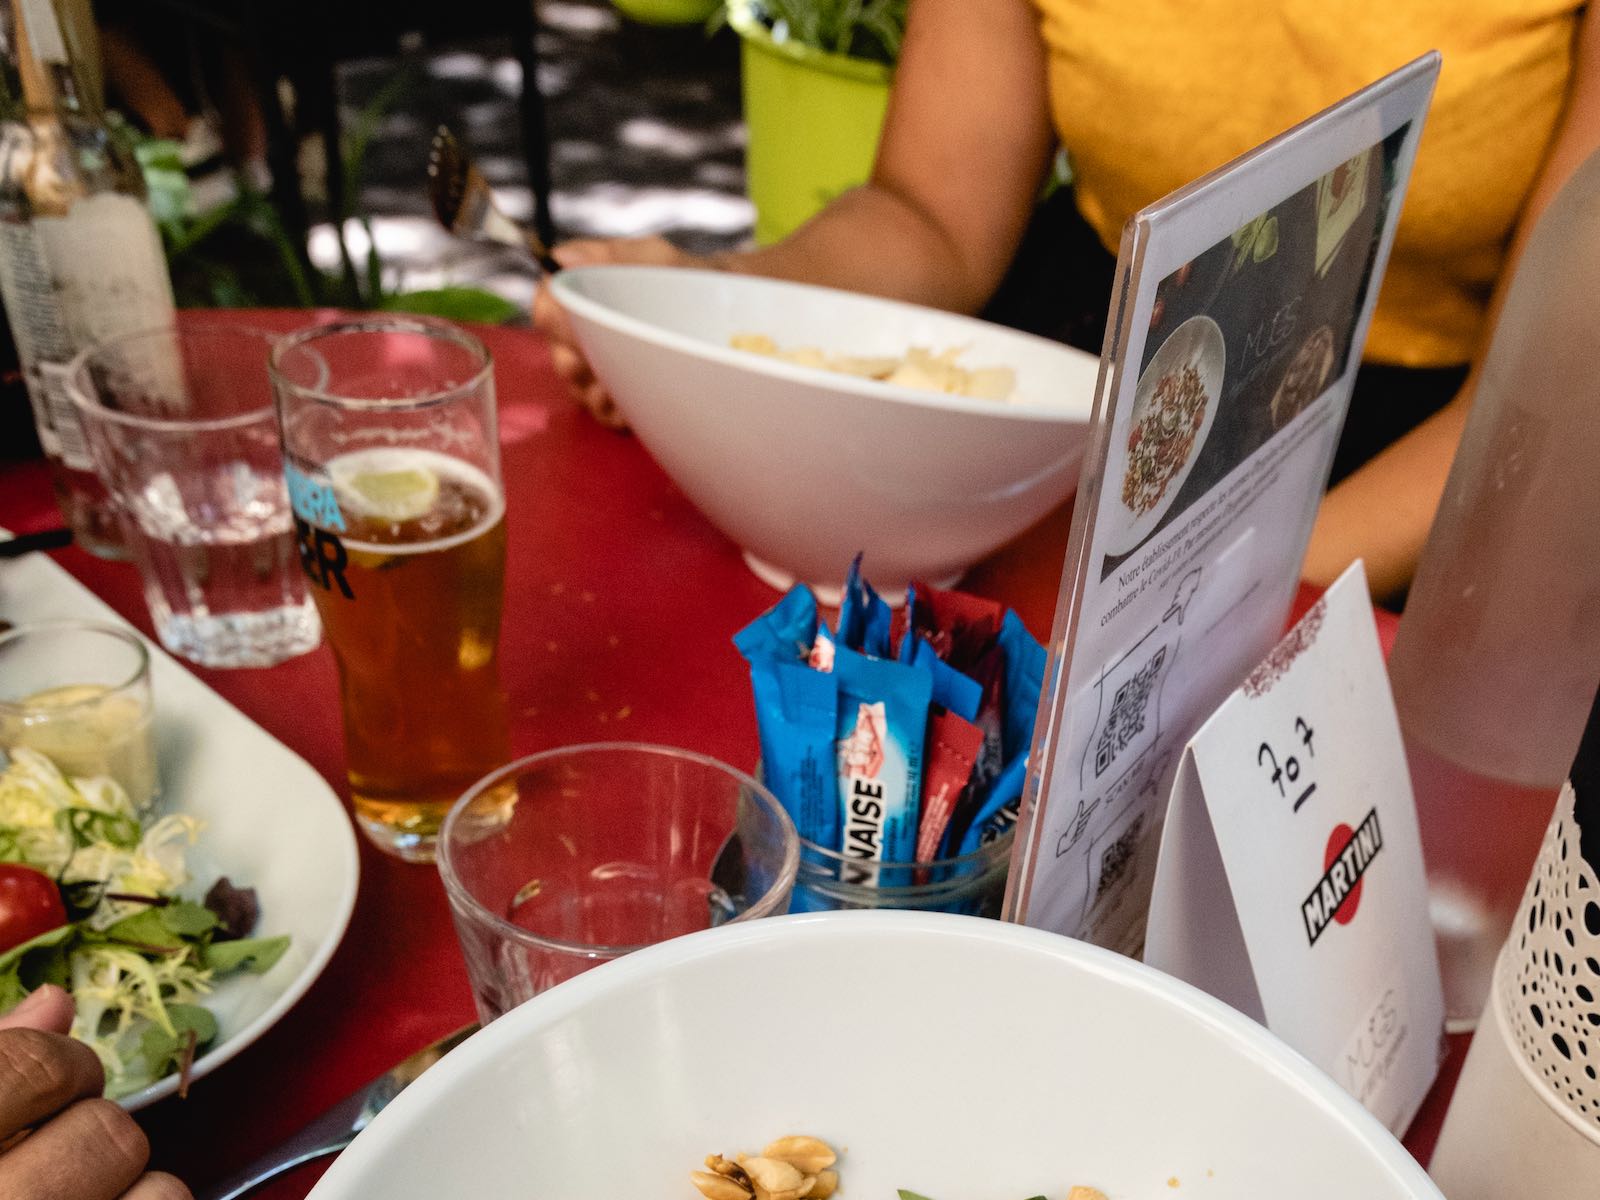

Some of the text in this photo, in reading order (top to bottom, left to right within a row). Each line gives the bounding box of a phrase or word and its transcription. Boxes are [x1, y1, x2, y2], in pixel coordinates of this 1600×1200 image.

[1118, 566, 1141, 592] Notre
[1100, 588, 1139, 627] combattre
[1302, 810, 1383, 944] MARTINI
